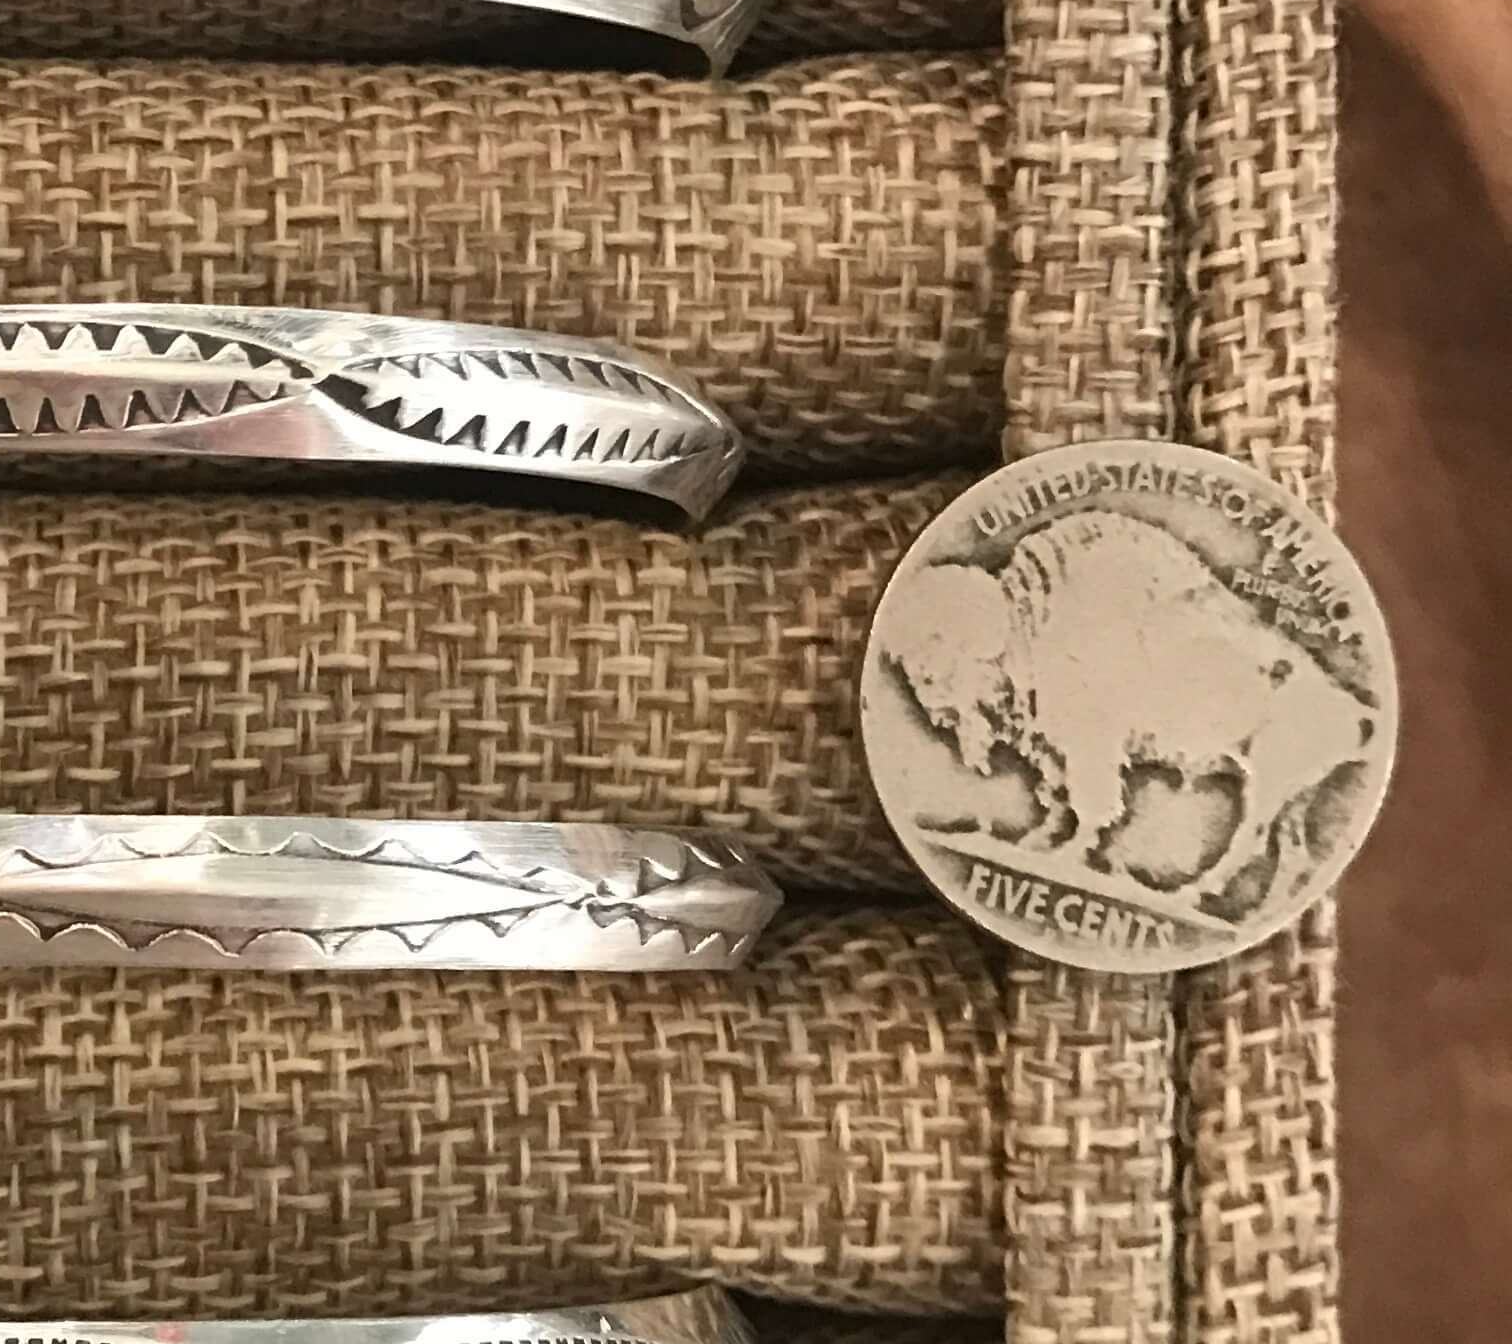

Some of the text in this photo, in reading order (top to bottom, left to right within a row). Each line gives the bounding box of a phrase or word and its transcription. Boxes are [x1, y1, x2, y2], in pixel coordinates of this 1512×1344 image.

[972, 468, 1090, 537] UNITED
[1097, 462, 1218, 505] STATES
[1221, 488, 1271, 526] OF
[968, 863, 1176, 953] FIVE CENTS
